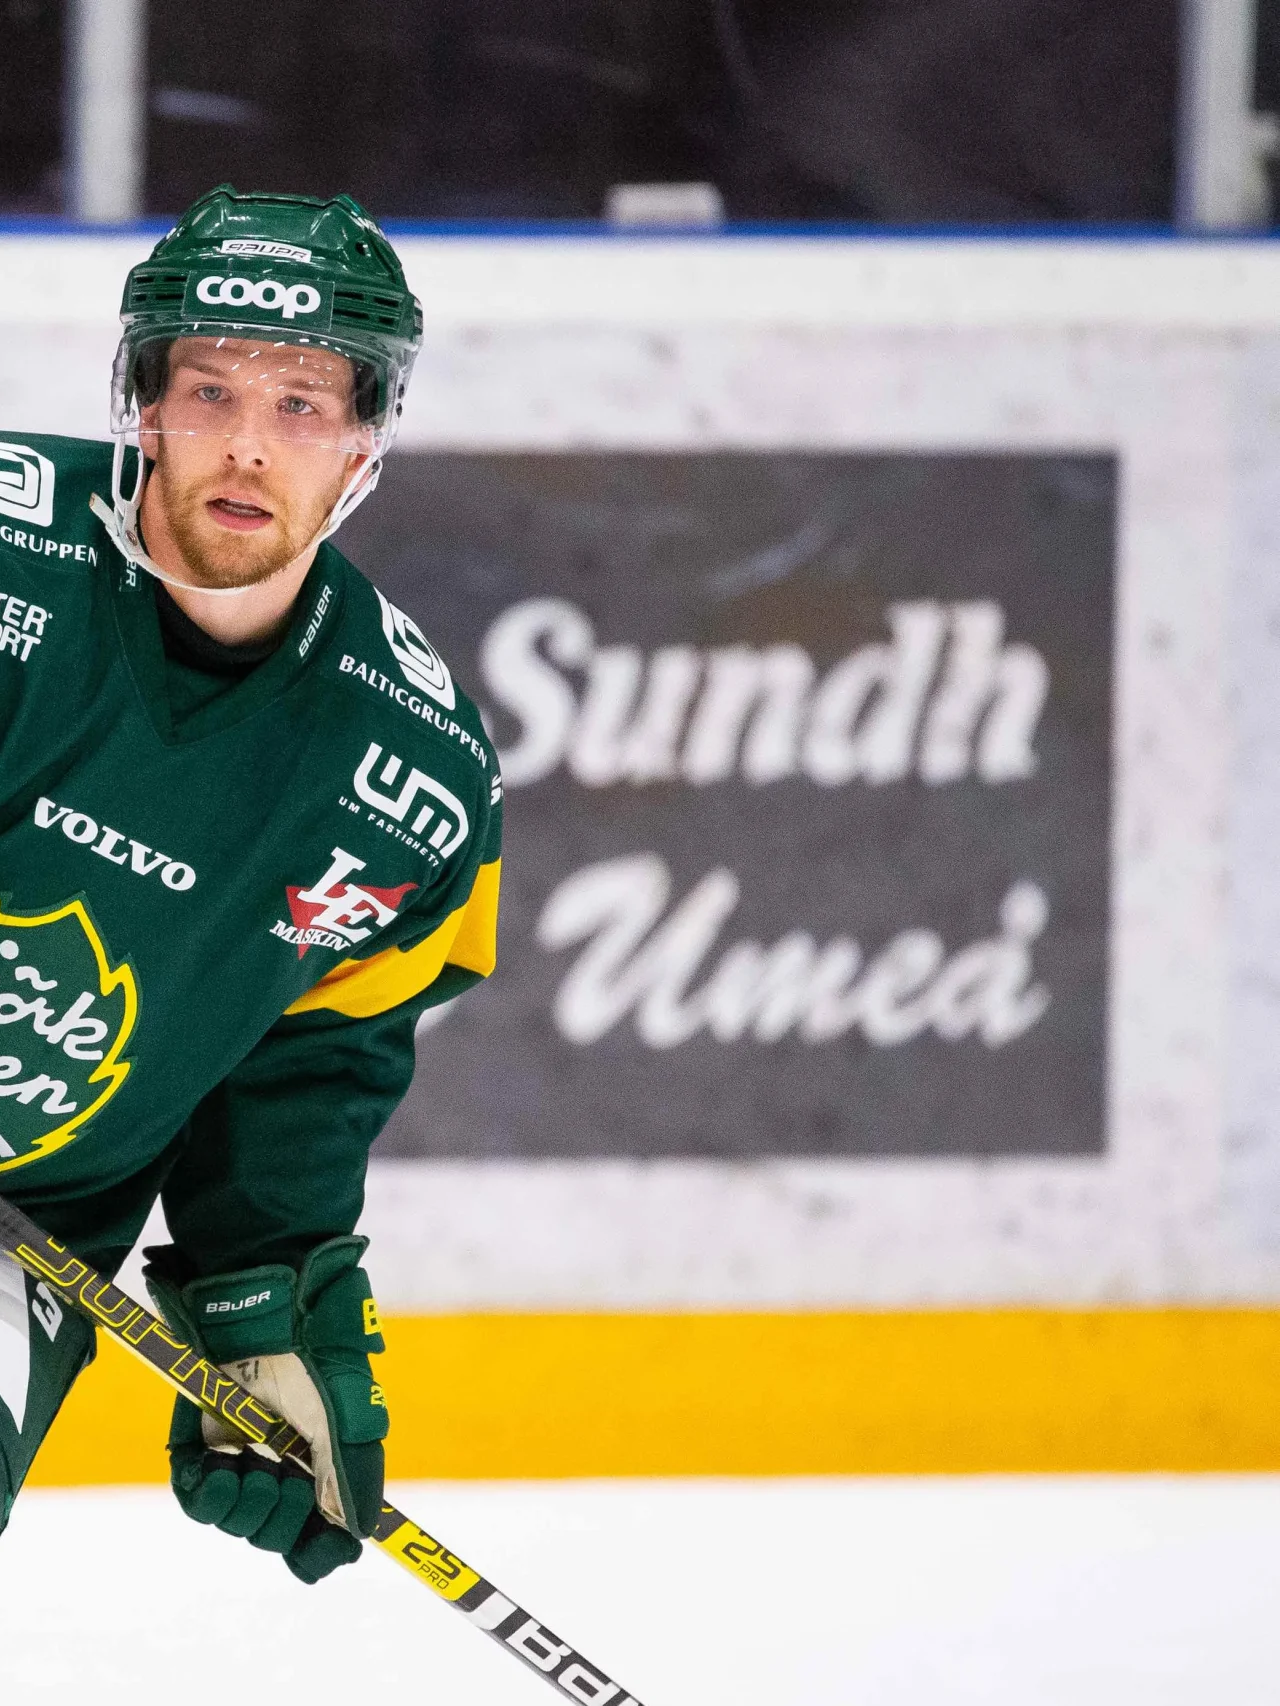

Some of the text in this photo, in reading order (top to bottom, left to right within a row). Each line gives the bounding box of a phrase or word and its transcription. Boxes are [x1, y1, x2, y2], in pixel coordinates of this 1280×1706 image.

[196, 275, 321, 319] coop
[339, 654, 488, 769] BALTICGRUPPEN
[478, 596, 1052, 790] Sundh
[338, 795, 361, 814] UM
[34, 796, 197, 892] VOLVO
[268, 919, 352, 953] MASKIN
[533, 852, 1052, 1050] Umeå
[205, 1290, 272, 1314] BAUER
[417, 1562, 451, 1591] PRO
